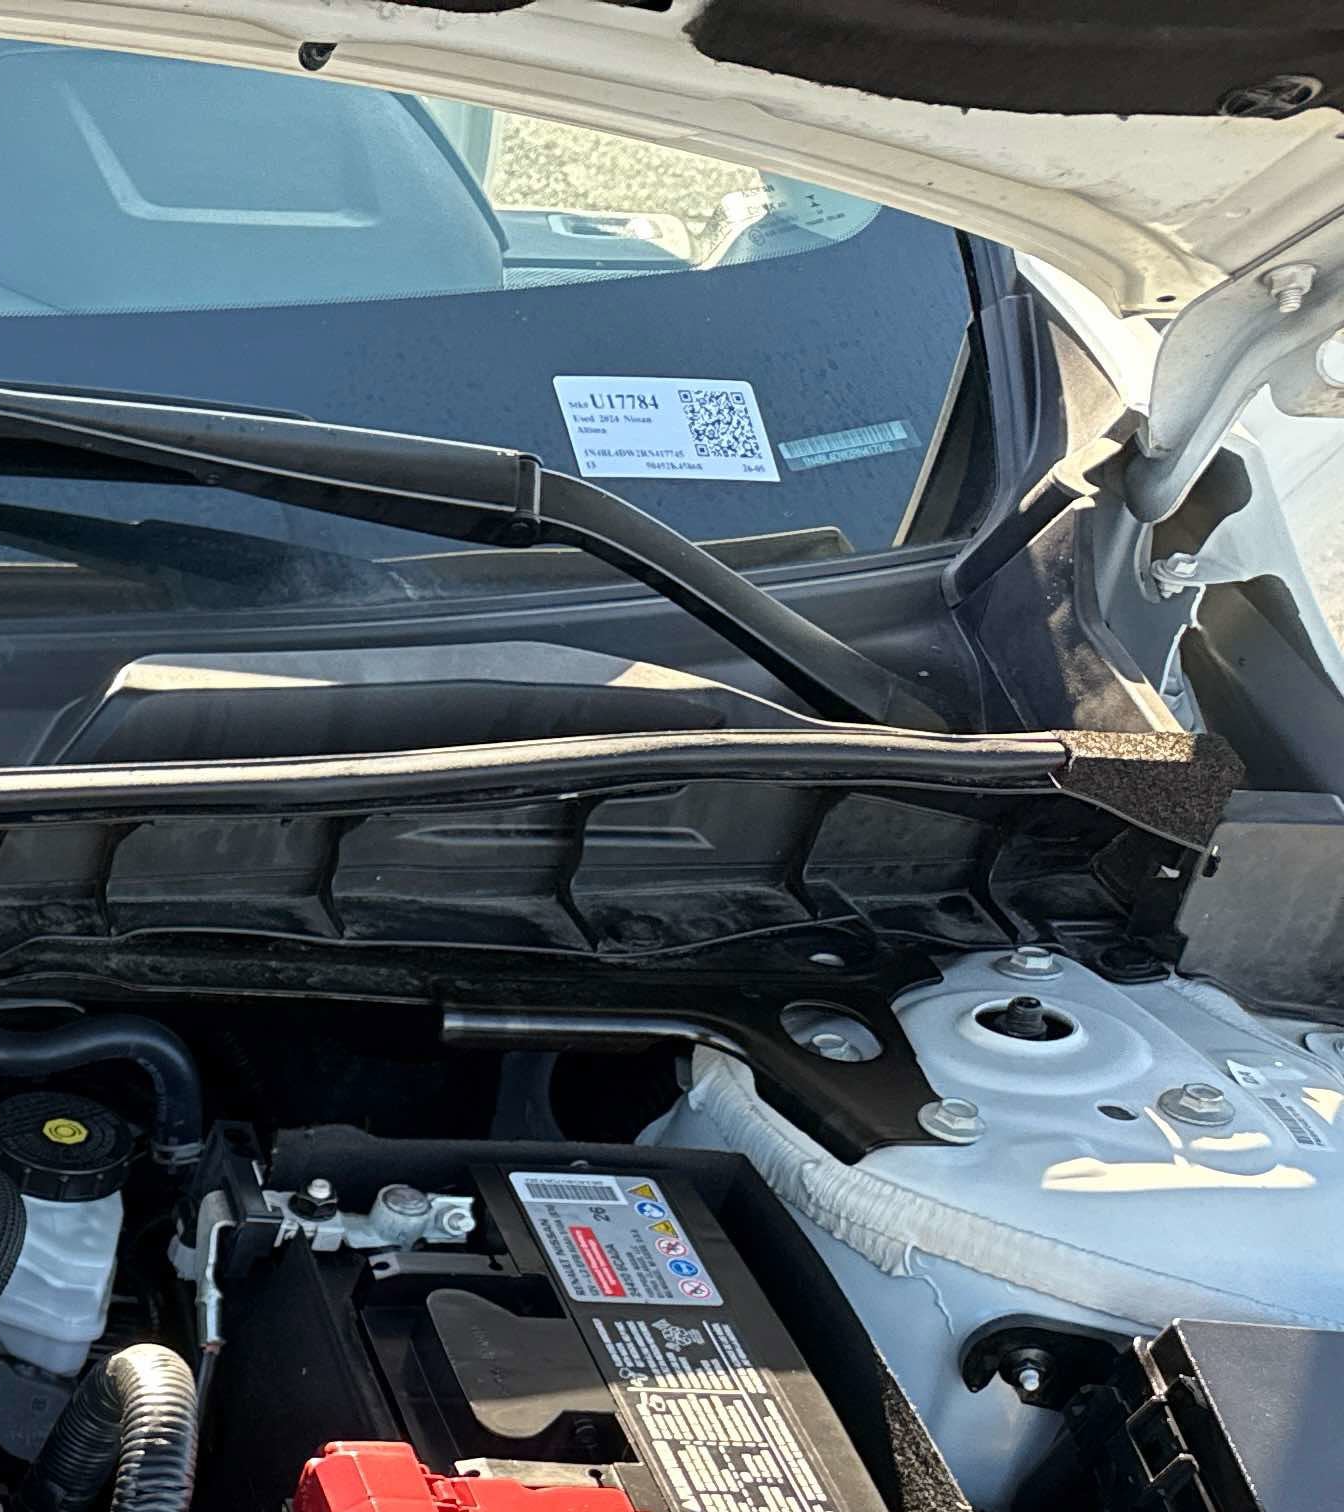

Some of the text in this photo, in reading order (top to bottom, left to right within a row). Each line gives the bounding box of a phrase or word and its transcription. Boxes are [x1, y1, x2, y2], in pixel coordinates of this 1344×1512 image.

[589, 393, 660, 410] U17784
[589, 1206, 610, 1222] 26
[540, 1218, 568, 1259] NISSAN
